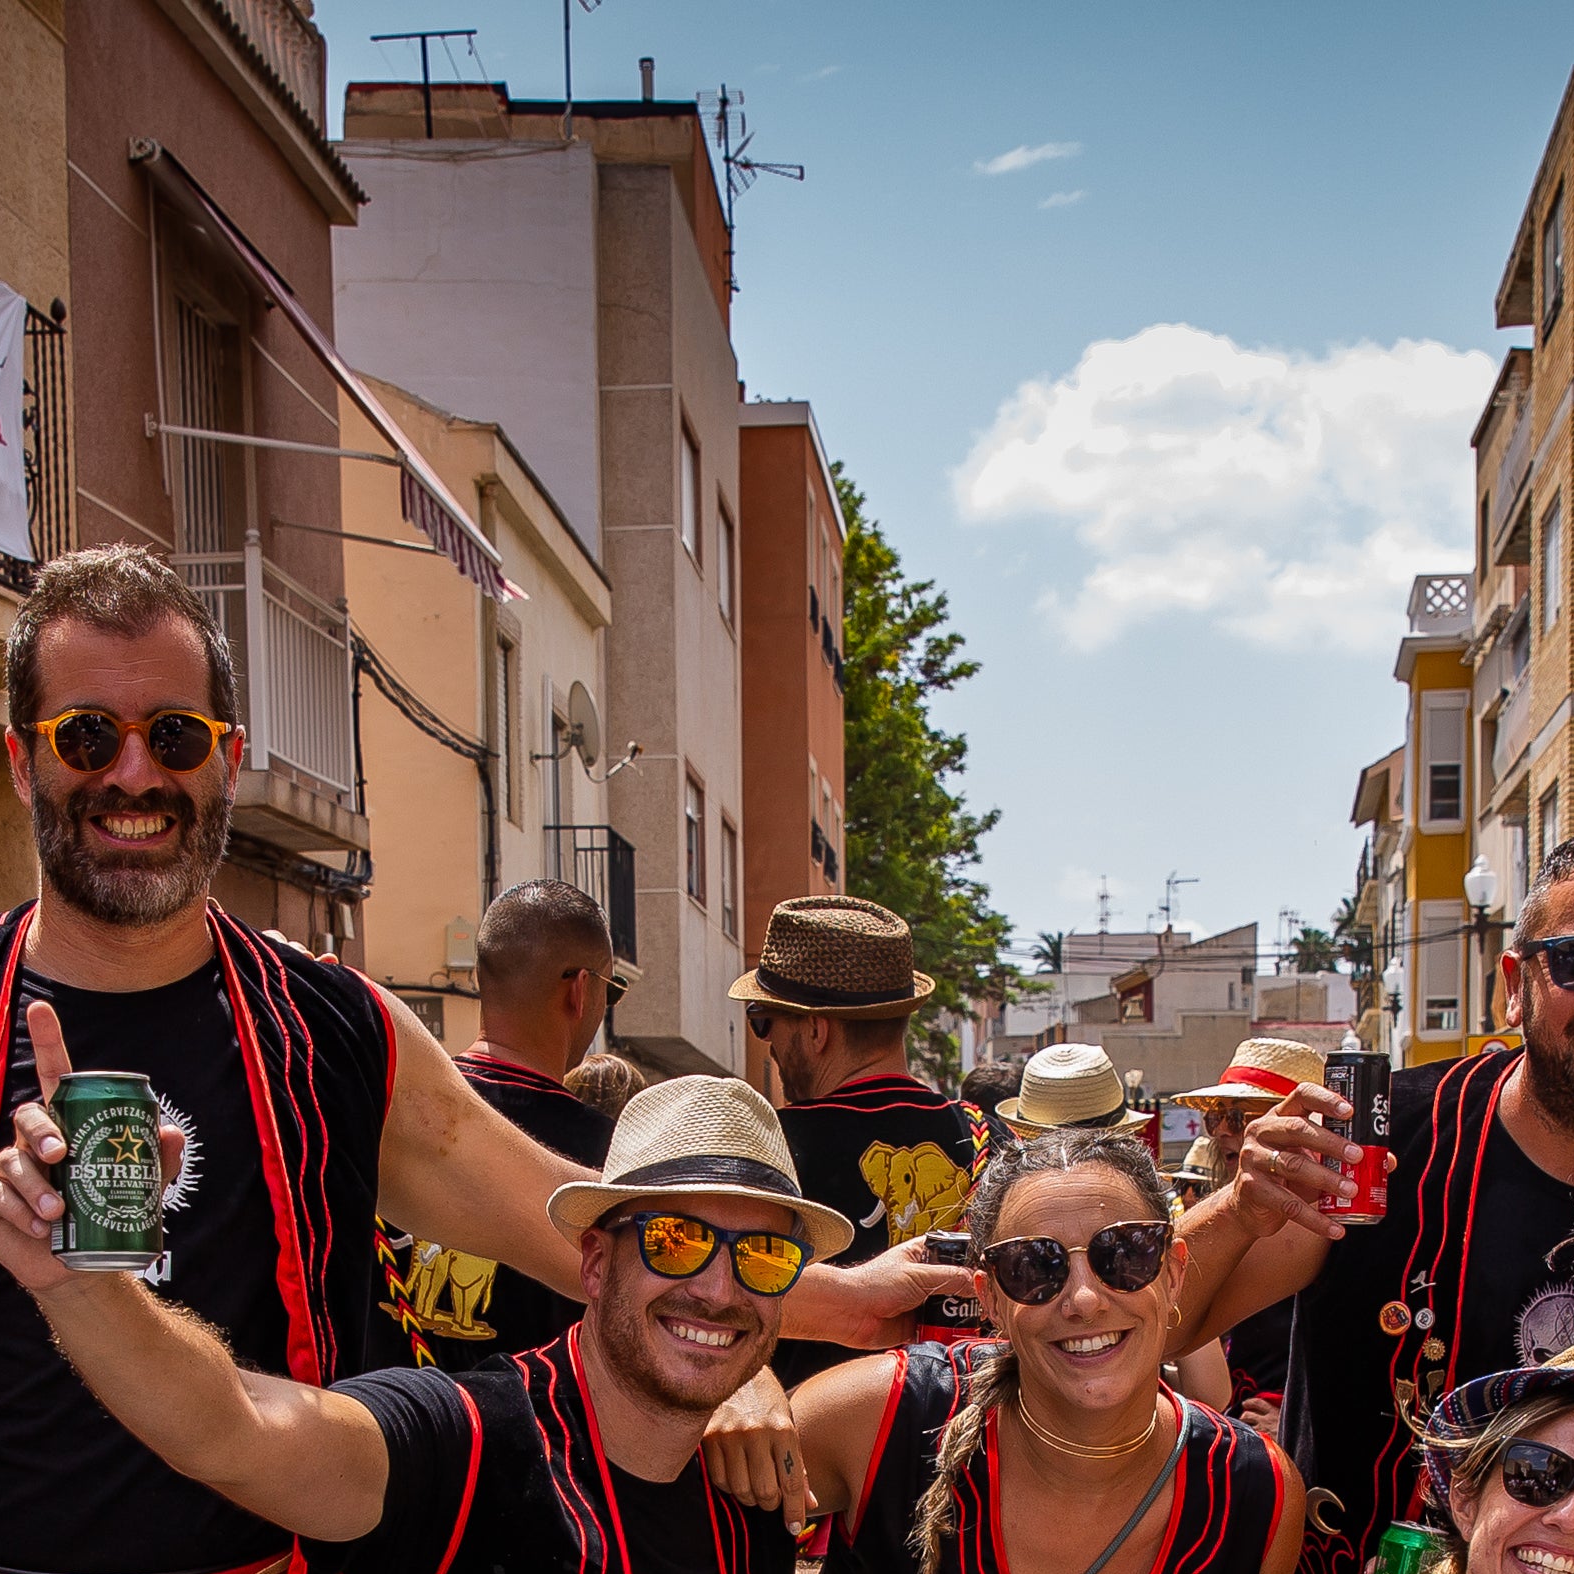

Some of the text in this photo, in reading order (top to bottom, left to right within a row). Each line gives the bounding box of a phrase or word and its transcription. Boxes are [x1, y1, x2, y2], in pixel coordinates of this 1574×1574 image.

[68, 1122, 92, 1158] MALTAS
[87, 1116, 97, 1126] Y
[95, 1106, 146, 1123] CERVEZAS
[96, 1180, 112, 1188] DE
[90, 1211, 135, 1233] CERVEZA
